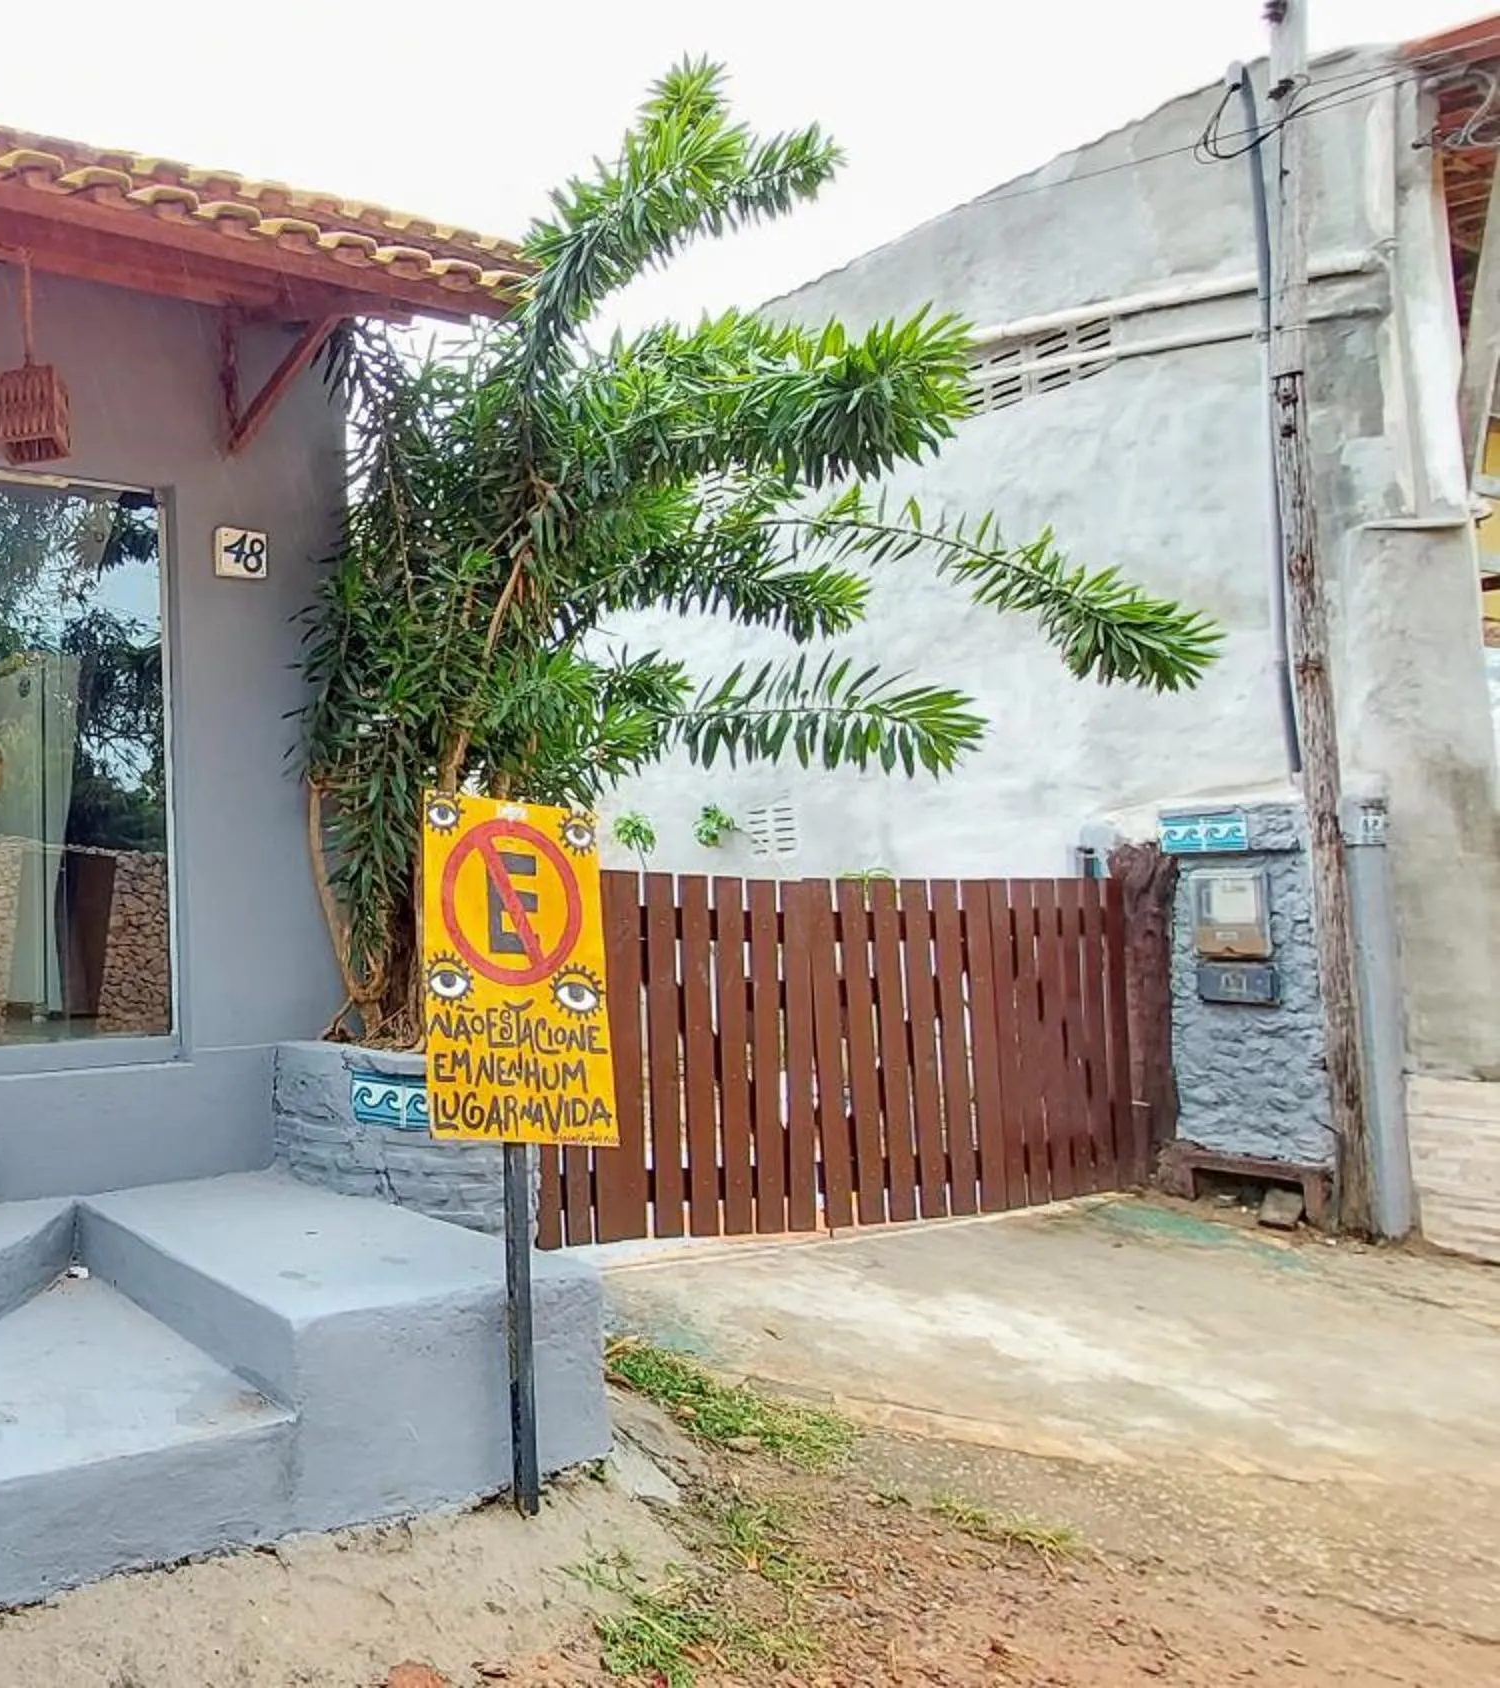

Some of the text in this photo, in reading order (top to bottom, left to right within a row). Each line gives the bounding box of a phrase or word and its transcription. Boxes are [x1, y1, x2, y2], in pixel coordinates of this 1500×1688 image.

[223, 533, 265, 573] 48
[487, 851, 539, 954] E
[428, 999, 608, 1054] NÃO ESTACIONE
[434, 1049, 588, 1094] EM NENHUM
[433, 1091, 612, 1137] LUGAR NA VIDA
